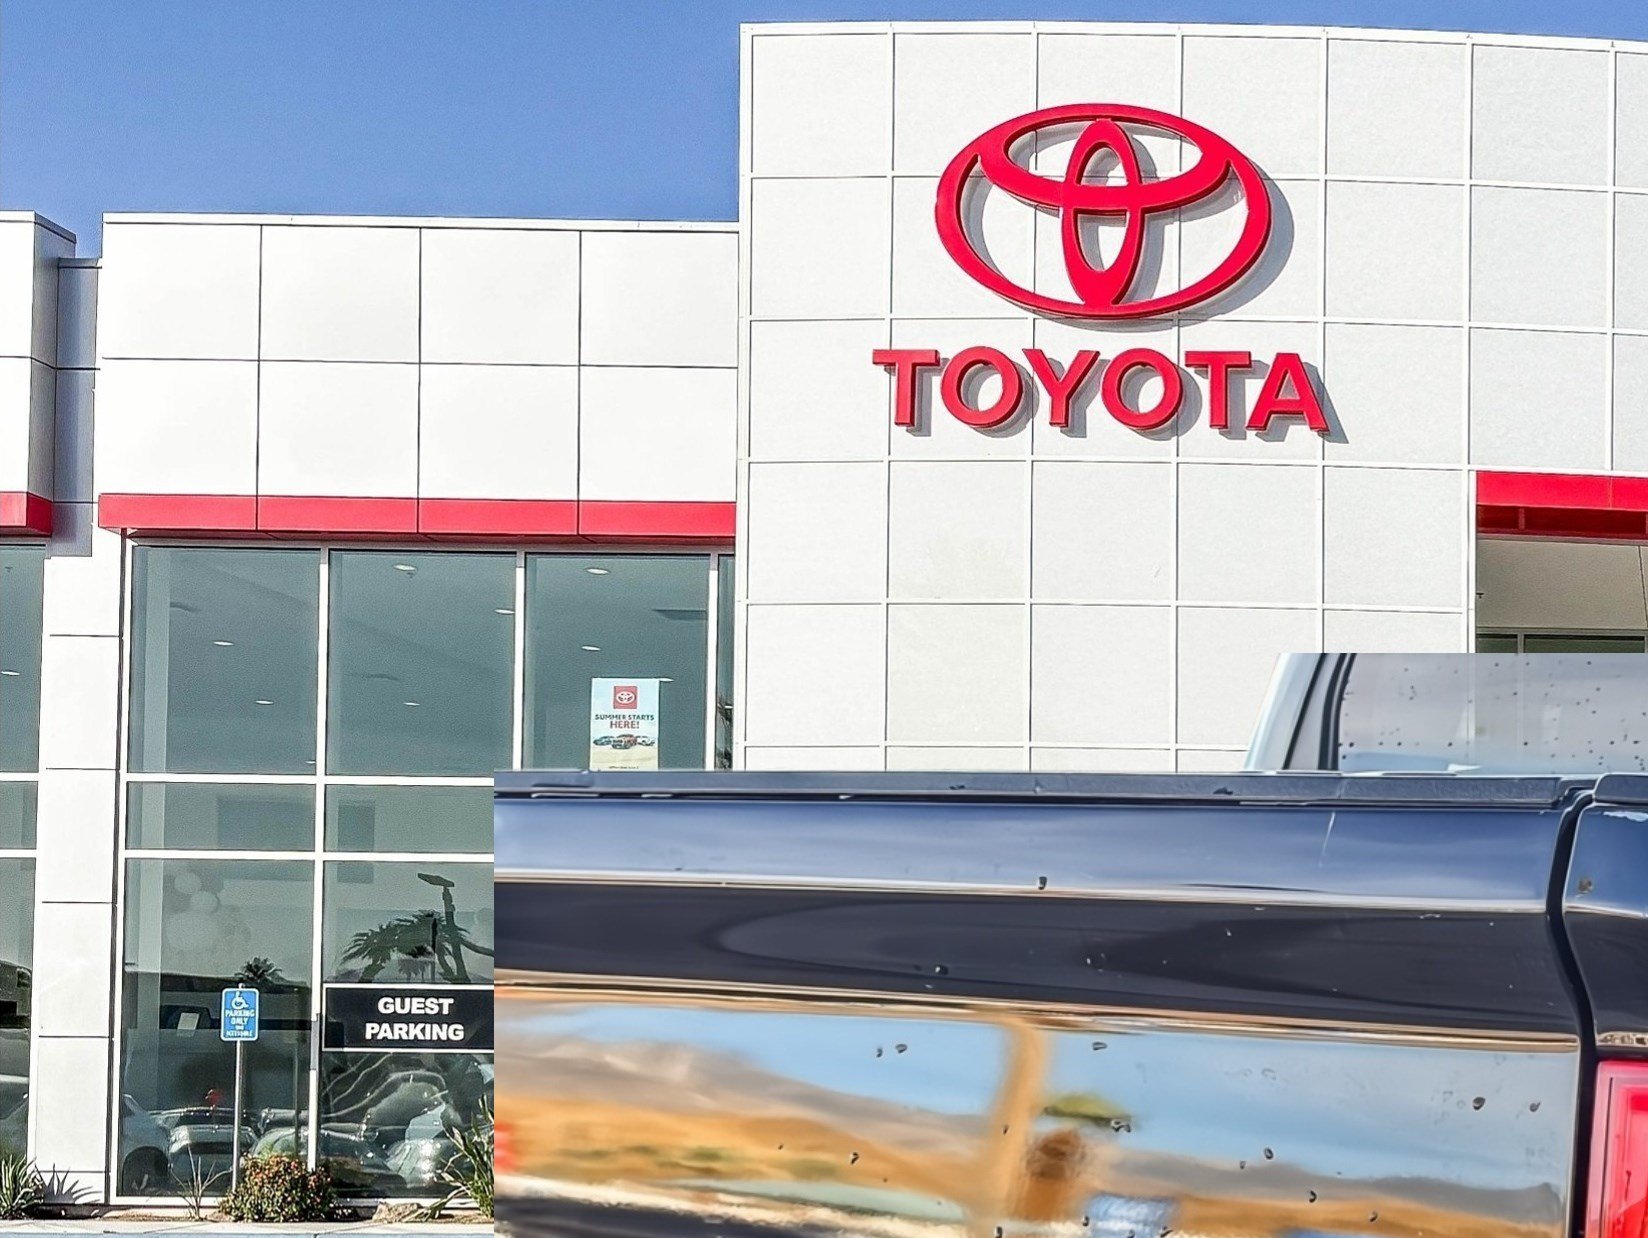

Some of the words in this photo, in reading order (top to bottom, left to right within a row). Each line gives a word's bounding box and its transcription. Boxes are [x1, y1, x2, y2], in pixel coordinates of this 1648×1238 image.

[872, 345, 1330, 434] TOYOTA
[609, 720, 640, 729] HERE!
[377, 996, 454, 1015] GUEST
[225, 1009, 255, 1017] PARKING
[230, 1017, 249, 1025] ONLY
[365, 1022, 465, 1041] PARKING
